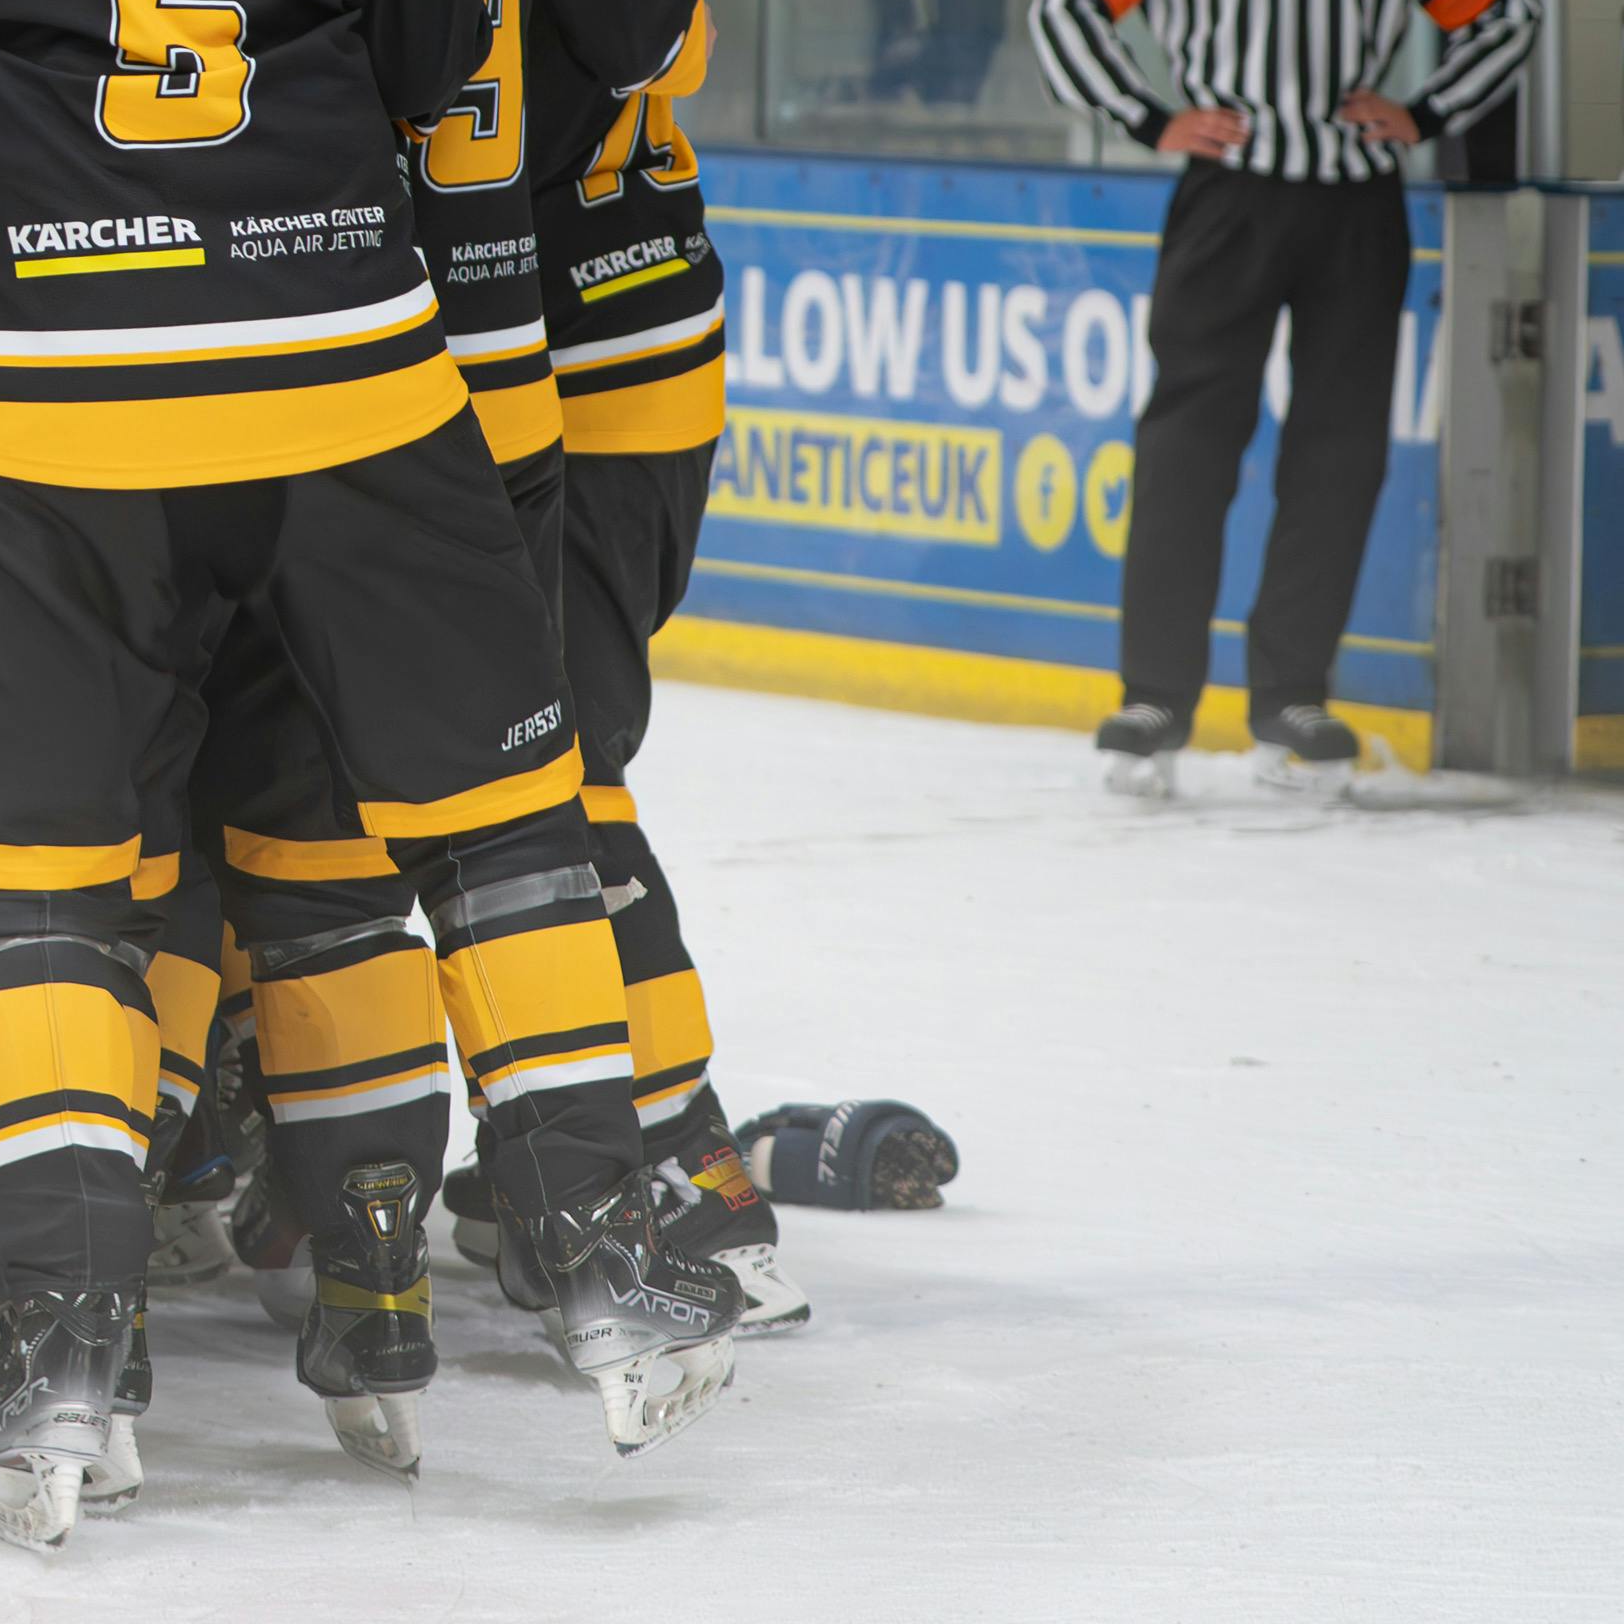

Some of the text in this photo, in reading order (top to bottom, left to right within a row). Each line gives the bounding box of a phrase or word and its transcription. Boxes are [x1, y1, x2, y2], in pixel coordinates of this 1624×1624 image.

[7, 215, 202, 255] KÄRCHER
[230, 205, 385, 237] KÄRCHER CENTER
[230, 228, 383, 262] AQUA AIR JETTING
[452, 236, 517, 262] KÄRCHER
[569, 236, 678, 288] KÄRCHER
[447, 261, 491, 283] AQUA
[494, 259, 515, 278] AIR
[725, 266, 928, 399] LOW
[943, 280, 1050, 413] US
[501, 698, 562, 752] JER53Y
[607, 1279, 710, 1332] VAPOR
